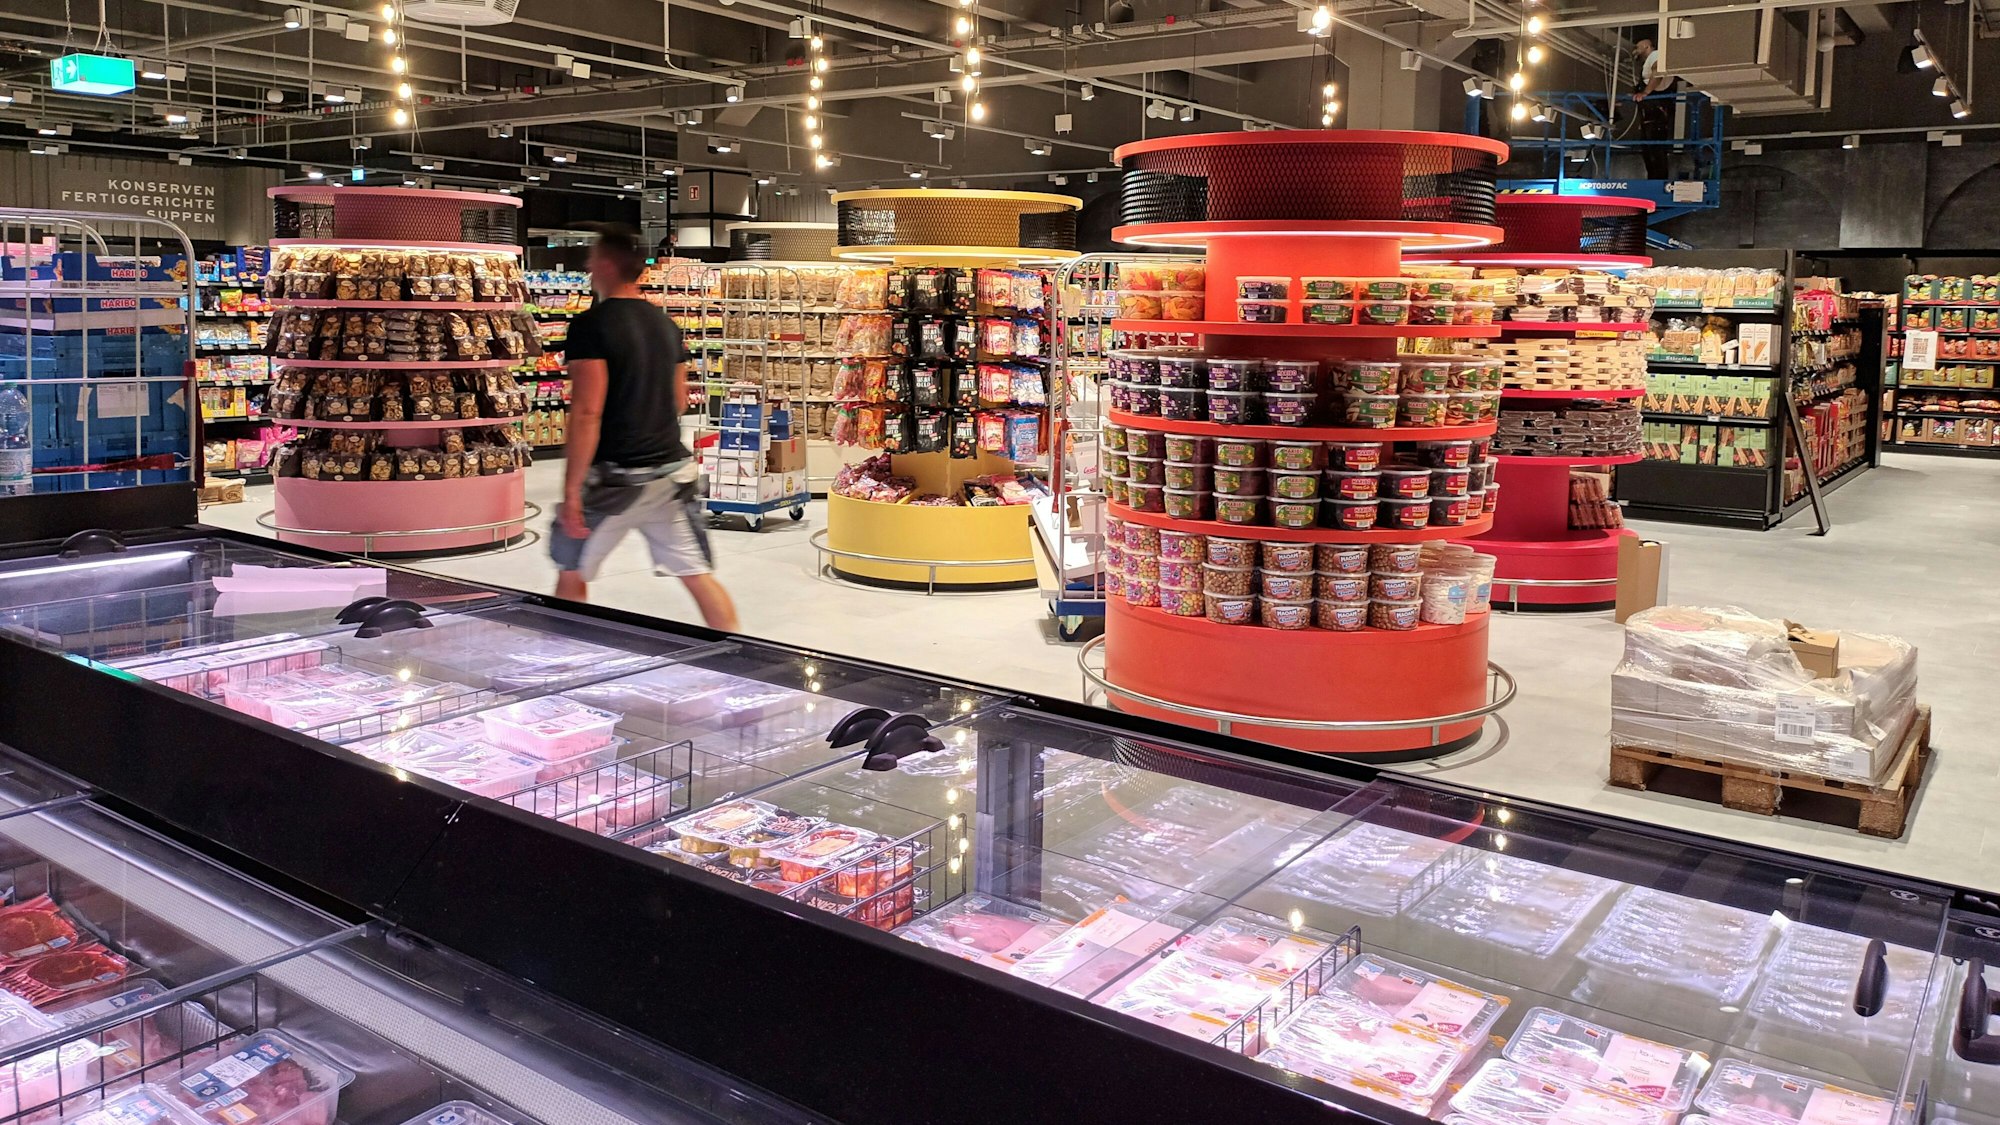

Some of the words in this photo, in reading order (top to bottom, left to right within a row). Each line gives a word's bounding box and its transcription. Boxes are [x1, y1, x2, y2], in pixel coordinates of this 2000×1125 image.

[108, 179, 215, 196] KONSERVEN
[61, 191, 215, 210] FERTIGGERICHTE
[147, 209, 215, 223] SUPPEN
[111, 269, 148, 279] HARIO
[106, 326, 142, 336] HARIB
